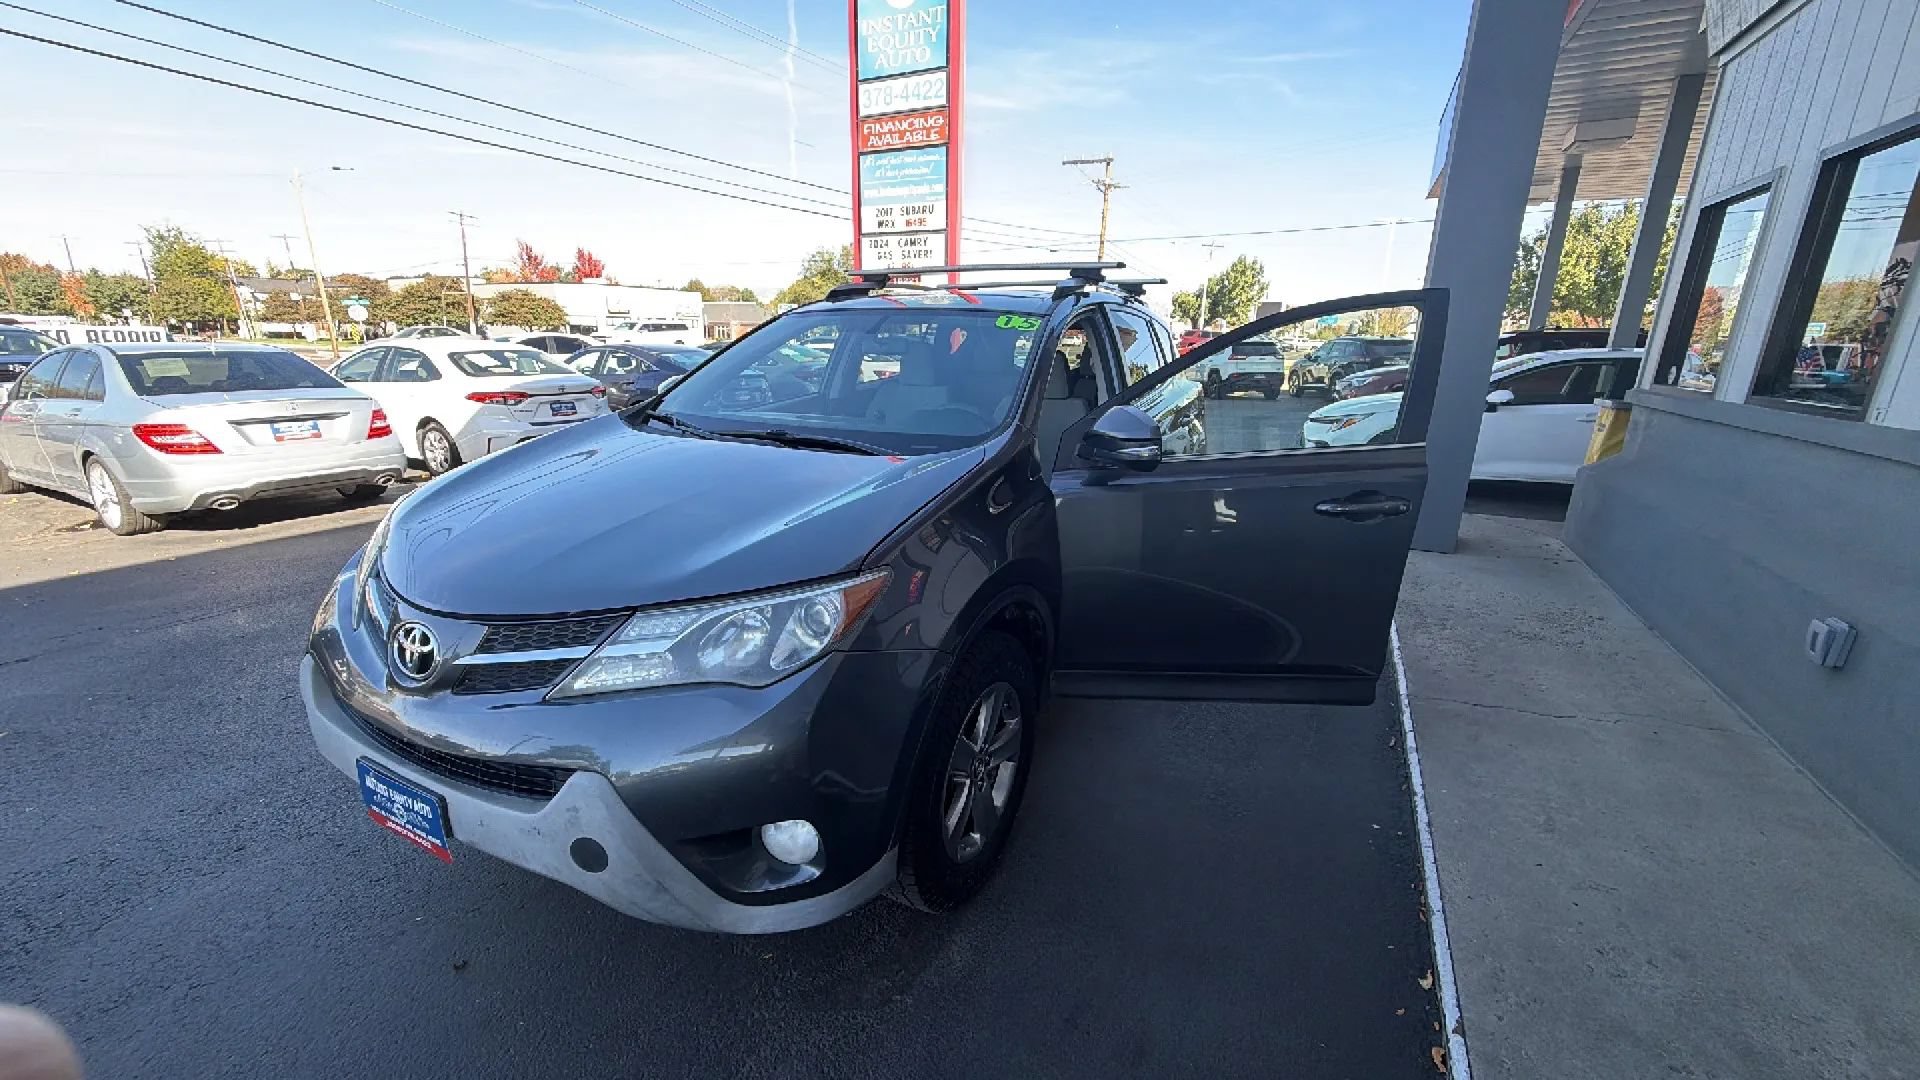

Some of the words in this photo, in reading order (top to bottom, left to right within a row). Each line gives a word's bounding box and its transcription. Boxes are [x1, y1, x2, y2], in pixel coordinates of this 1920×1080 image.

[862, 5, 945, 36] INSTANT
[867, 25, 940, 53] EQUITY
[874, 46, 931, 70] AUTO
[863, 77, 945, 109] 378-4422
[863, 115, 945, 135] FINANCING
[867, 128, 941, 146] AVAILABLE
[876, 207, 894, 218] 2017
[900, 204, 935, 216] SUBARU
[877, 219, 896, 229] WRX
[869, 239, 889, 249] 2024
[897, 236, 929, 248] CAMRY
[877, 250, 893, 260] GAS
